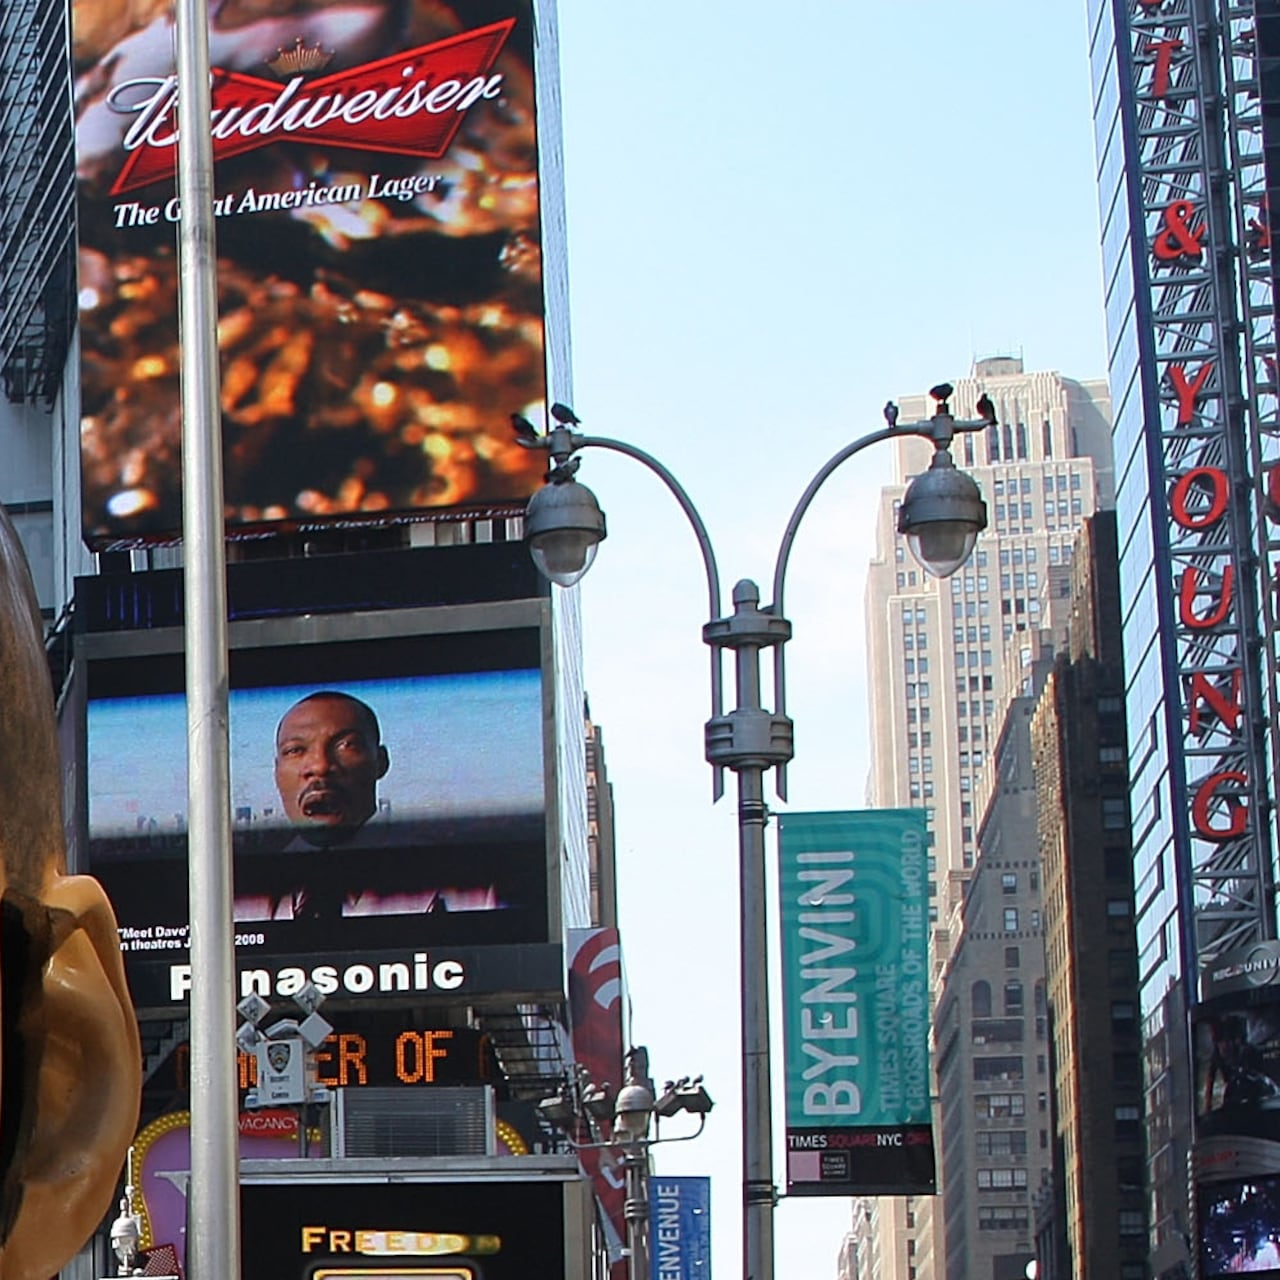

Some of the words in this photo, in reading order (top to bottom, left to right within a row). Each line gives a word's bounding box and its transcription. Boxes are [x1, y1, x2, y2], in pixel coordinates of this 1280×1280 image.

[106, 66, 504, 150] Budweiser
[113, 202, 160, 228] The
[164, 193, 235, 222] Gat
[237, 181, 364, 214] American
[367, 172, 443, 204] Lager
[902, 829, 922, 897] WORLD
[130, 937, 182, 950] theatres
[235, 933, 265, 946] 2008
[902, 903, 922, 945] THE
[170, 953, 465, 1001] Pnasonic
[797, 851, 861, 1116] BYENVINI
[903, 950, 923, 975] OF
[875, 963, 897, 1048] SQUARE
[396, 1030, 454, 1084] OF
[902, 977, 926, 1111] CROSSROADS
[882, 1052, 898, 1113] TIMES
[237, 1117, 299, 1130] VACANCY
[301, 1226, 501, 1256] FREEDOM
